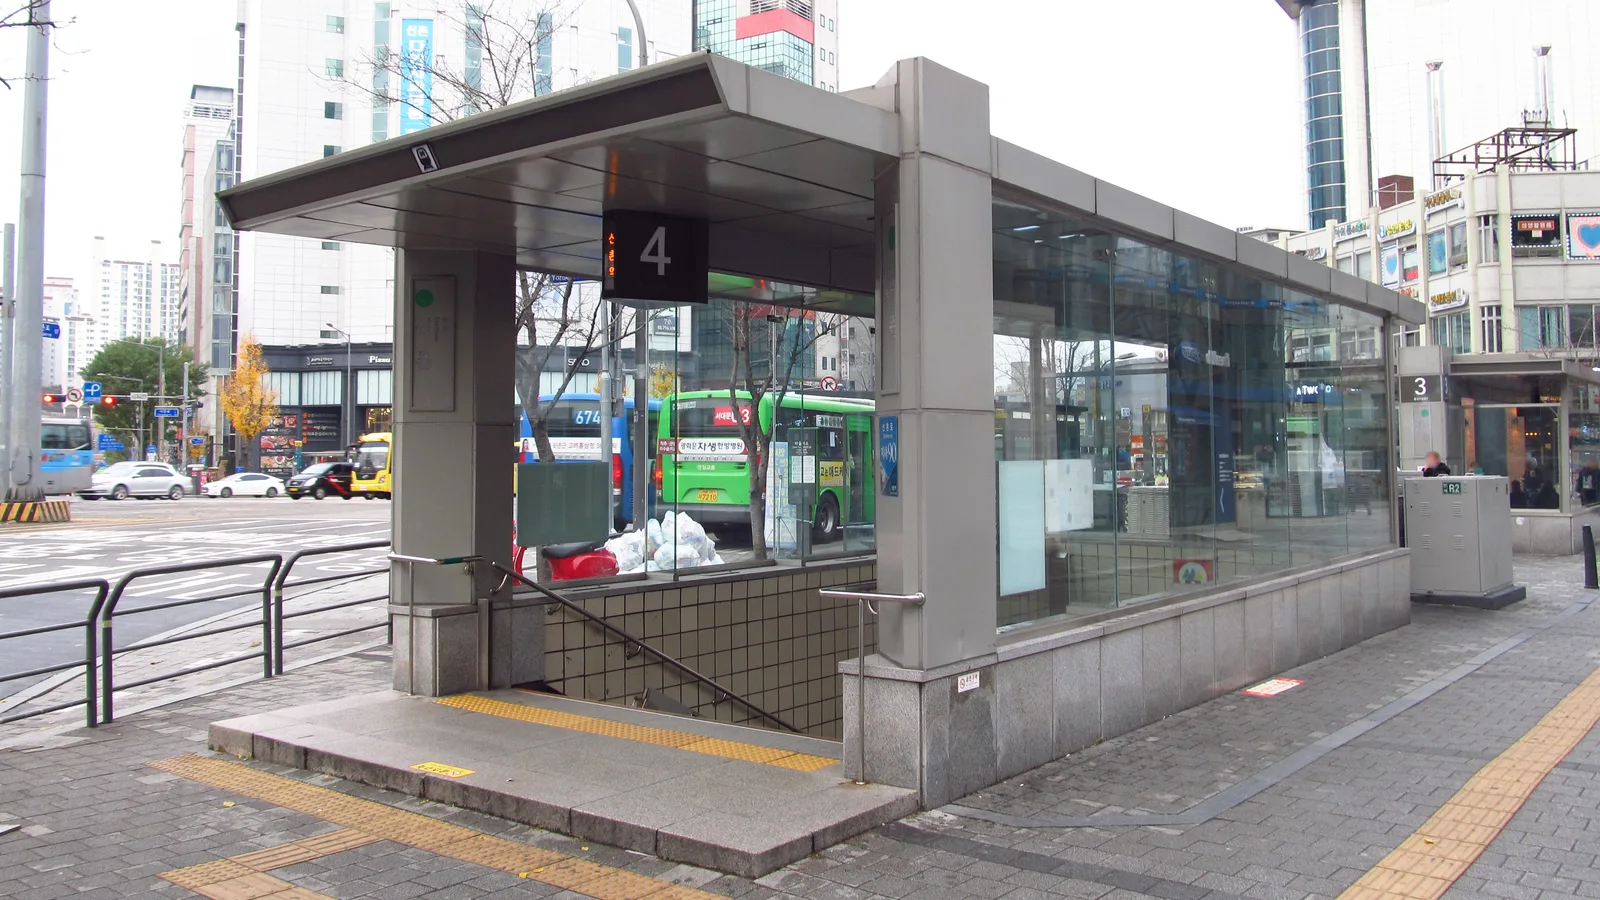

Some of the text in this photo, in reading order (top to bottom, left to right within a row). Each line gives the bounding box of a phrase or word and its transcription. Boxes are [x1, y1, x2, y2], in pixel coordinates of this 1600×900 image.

[640, 226, 671, 275] 4
[567, 358, 590, 366] SO
[1414, 377, 1427, 396] 3
[575, 410, 601, 425] 674
[1449, 483, 1460, 492] R2
